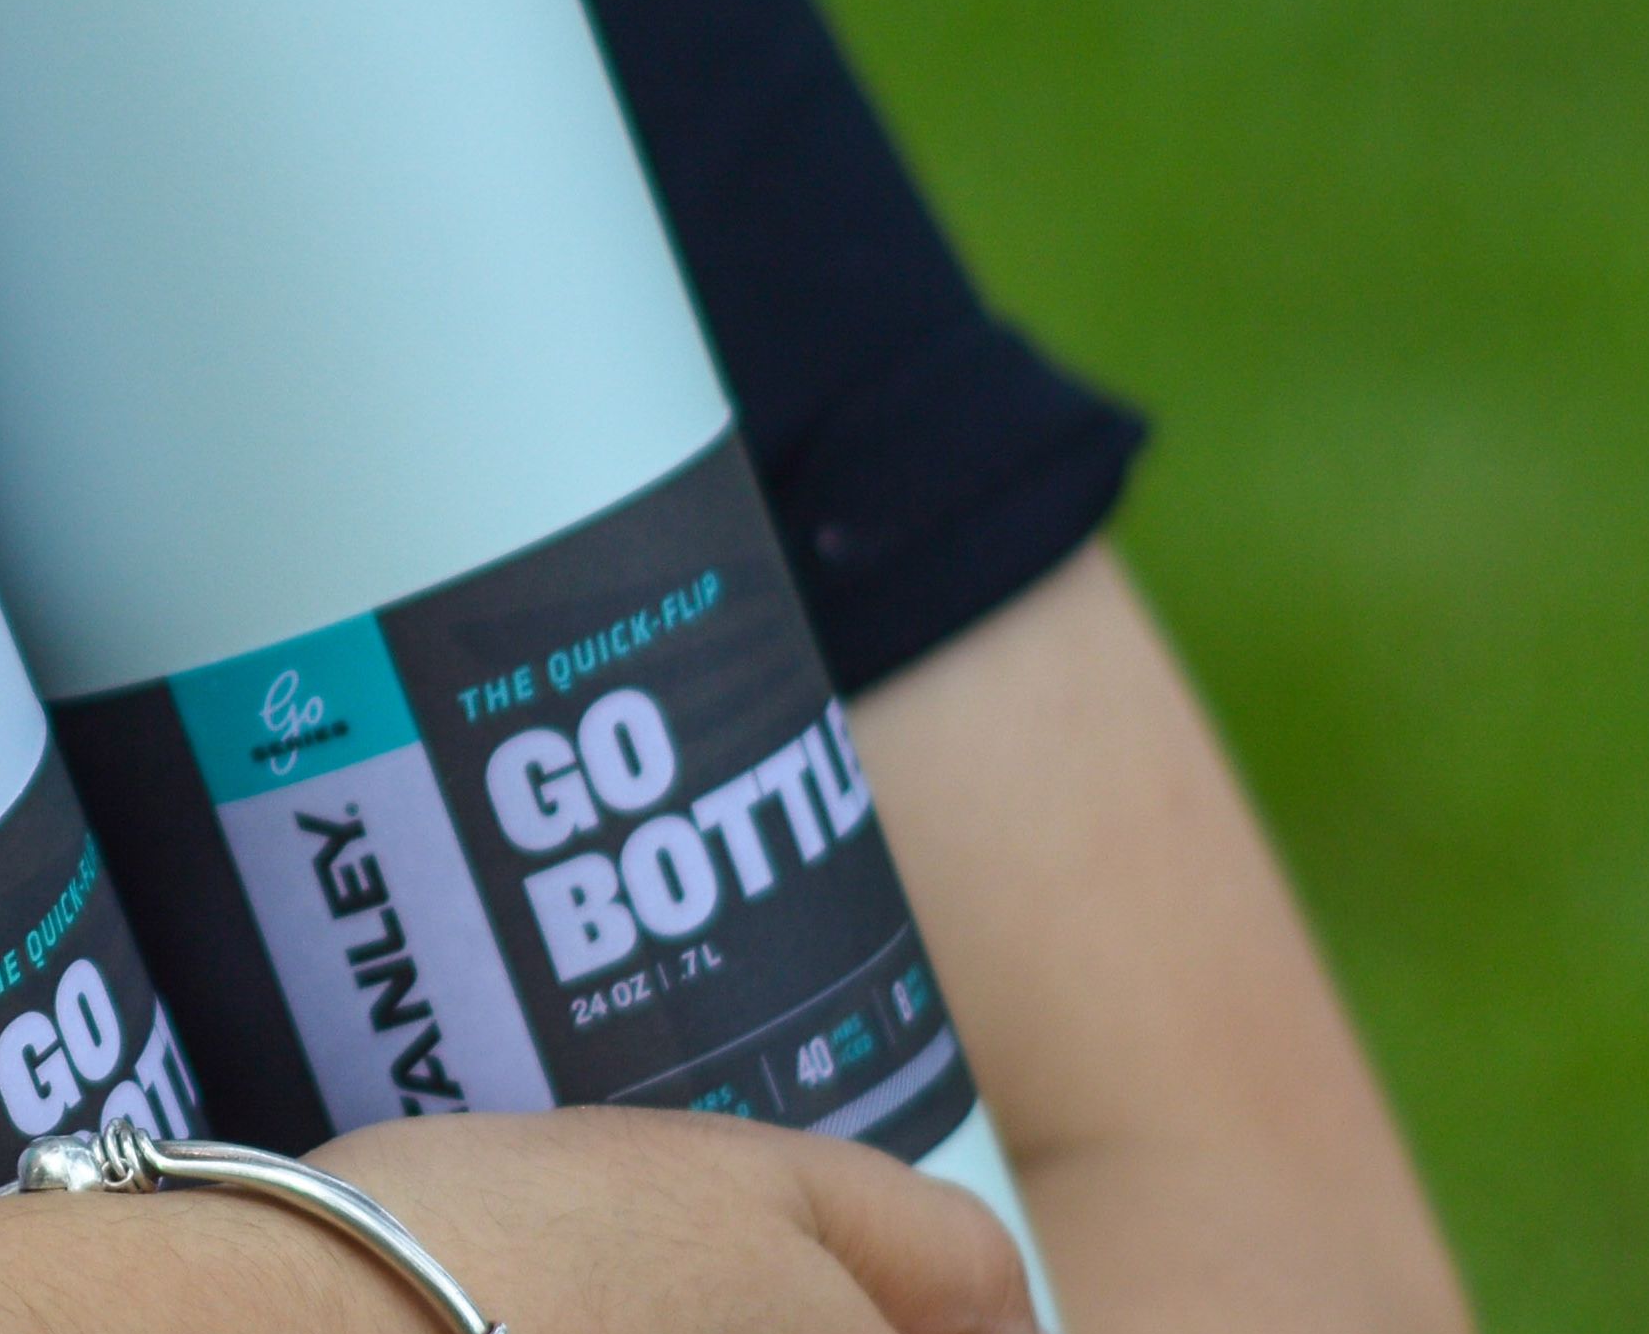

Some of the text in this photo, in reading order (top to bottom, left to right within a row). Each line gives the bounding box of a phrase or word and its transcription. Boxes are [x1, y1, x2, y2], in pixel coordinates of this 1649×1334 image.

[258, 669, 325, 776] Go
[457, 569, 721, 723] THE QUICK-FLIP
[485, 686, 677, 852] GO
[522, 696, 870, 984] BOTTL
[294, 810, 469, 1116] ANLEY
[571, 991, 607, 1025] 24
[611, 971, 651, 1007] OZ
[798, 1035, 834, 1086] 40
